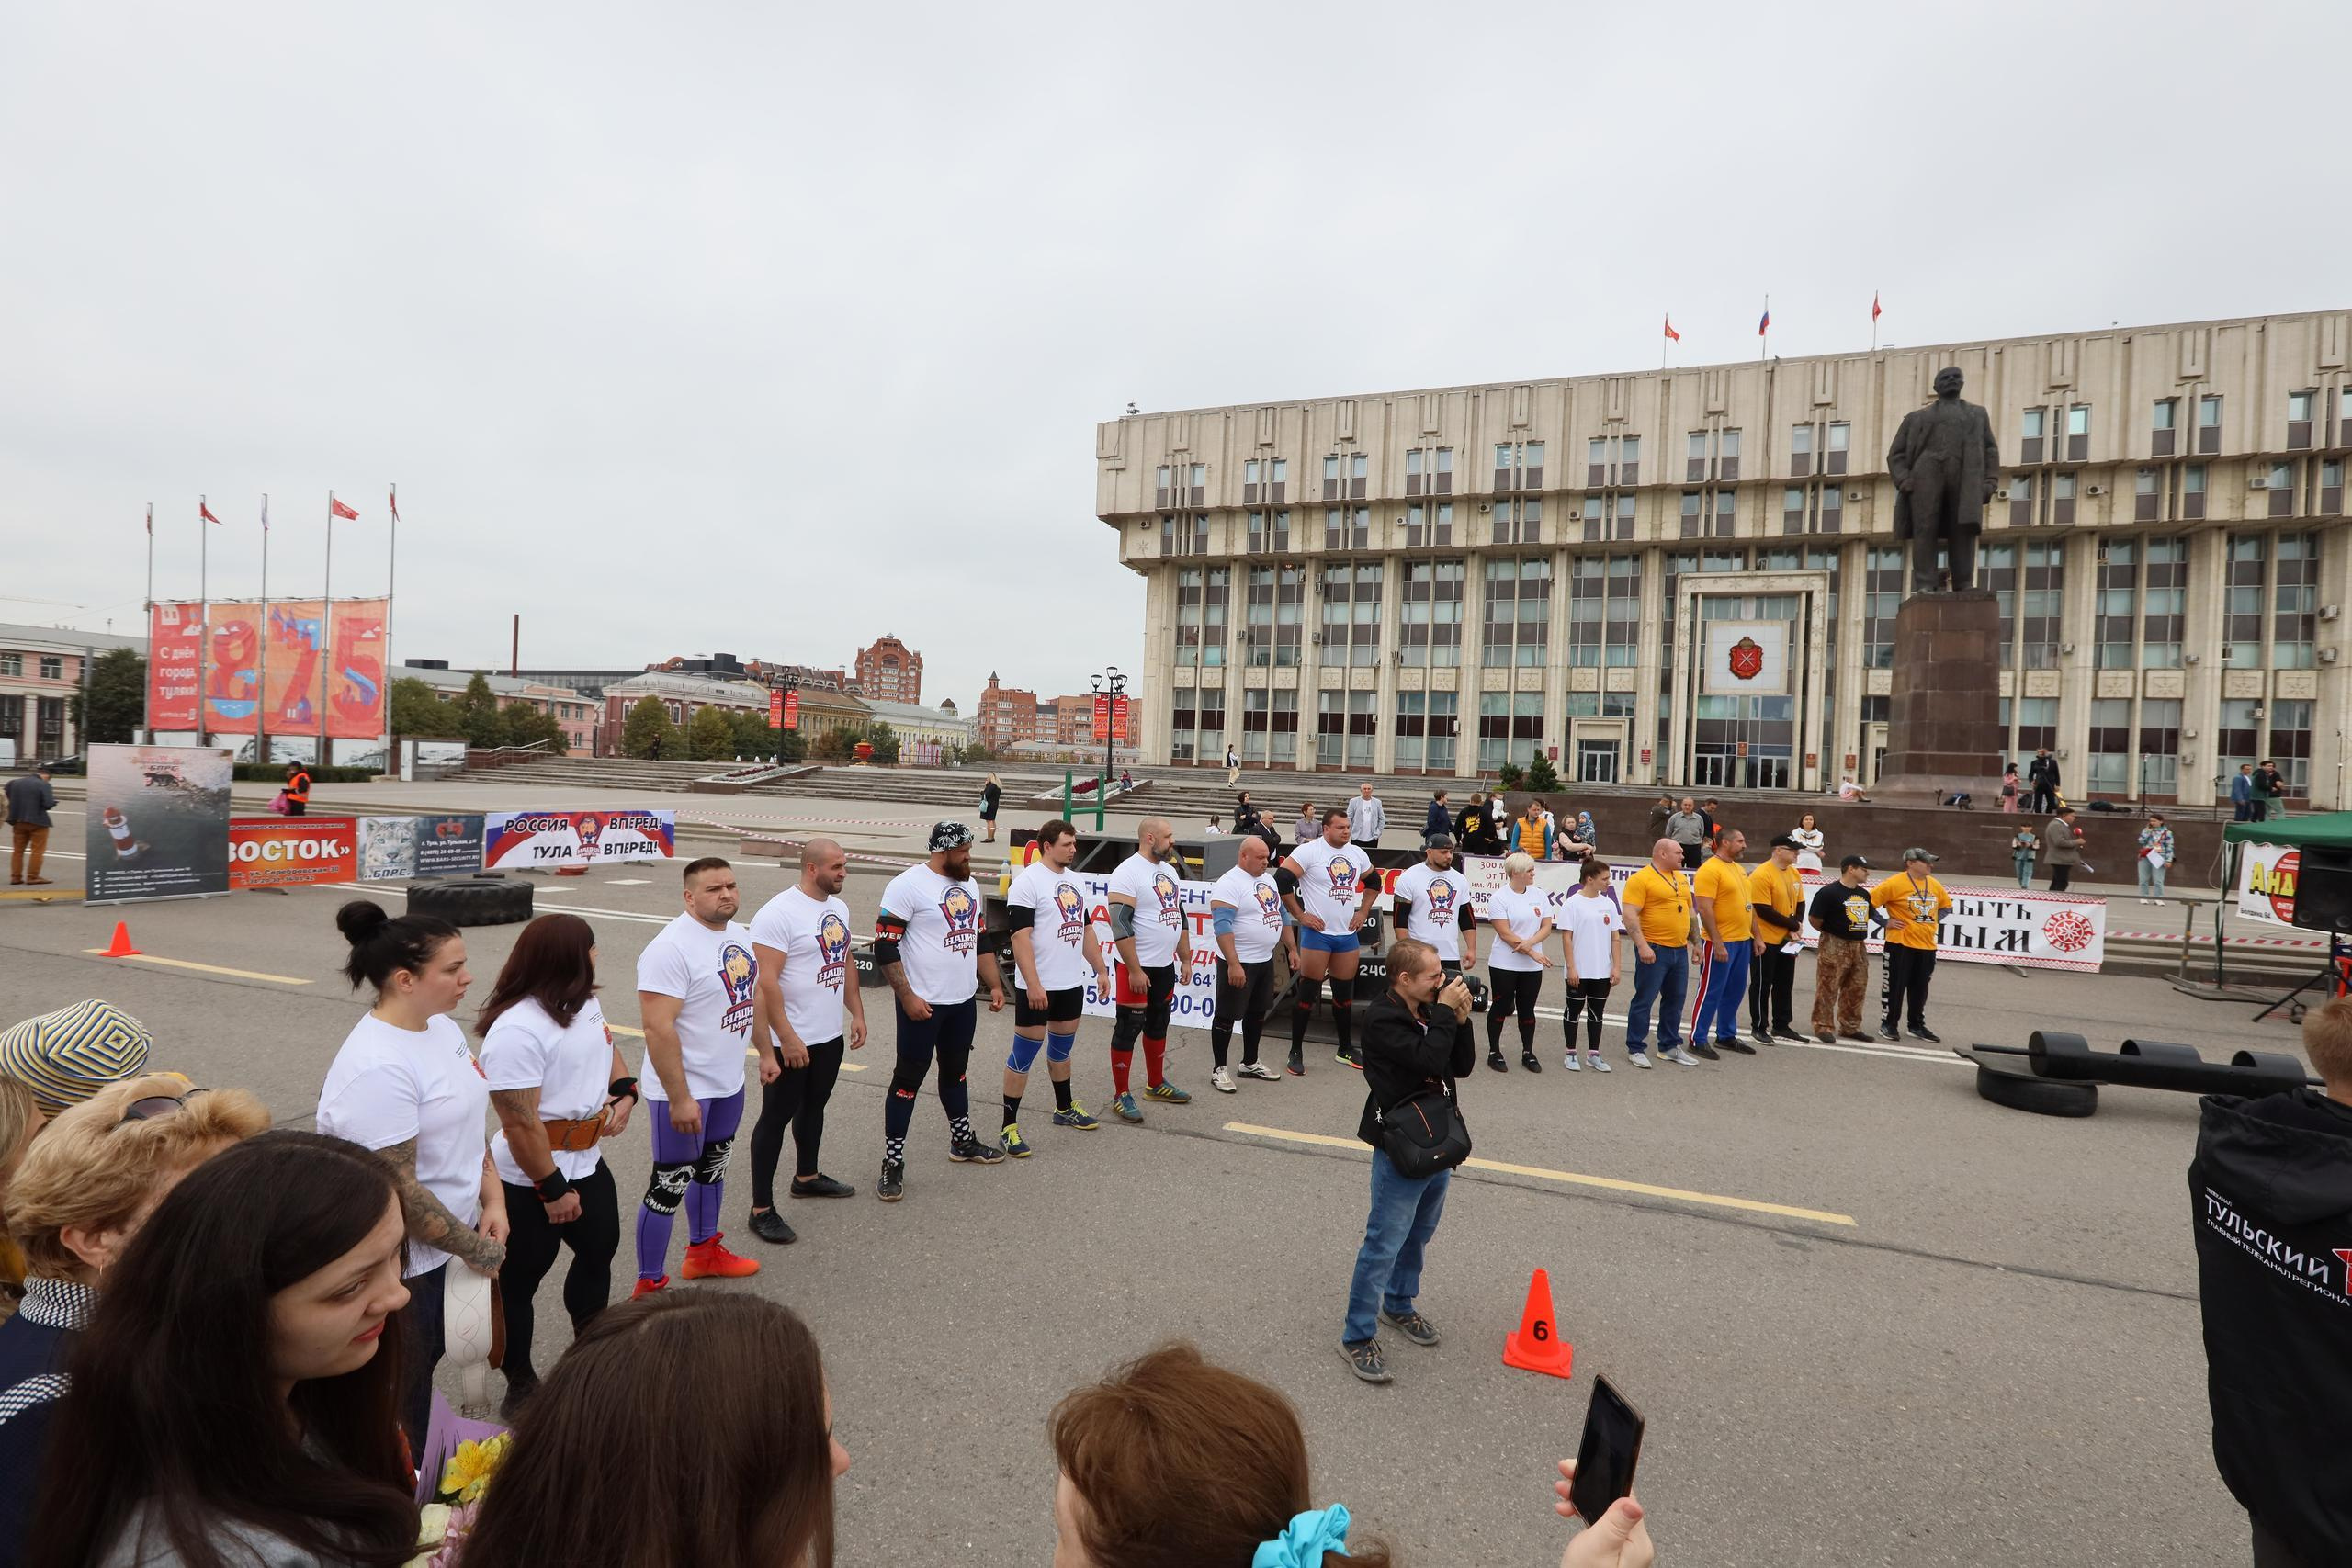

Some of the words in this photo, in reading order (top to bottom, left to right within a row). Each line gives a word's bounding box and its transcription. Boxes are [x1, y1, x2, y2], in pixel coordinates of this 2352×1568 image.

[159, 647, 170, 658] С
[503, 819, 569, 832] РОССИЯ
[609, 817, 662, 829] ВПЕРЕД!
[534, 845, 572, 860] ТУЛА
[604, 841, 658, 855] ВПЕРЕД!
[1480, 862, 1497, 870] 300
[1951, 899, 2031, 920] ЫТЬ
[1359, 964, 1386, 976] 240
[2206, 1187, 2233, 1207] ТЕЛЕКАНАЛ
[2205, 1193, 2329, 1285] ТУЛЬСКИЙ
[2207, 1218, 2241, 1247] ГЛАВНЫЙ
[2242, 1241, 2291, 1279] ТЕЛЕКАНАЛ
[2292, 1275, 2352, 1307] РЕГИОНА
[1533, 1320, 1549, 1341] 6
